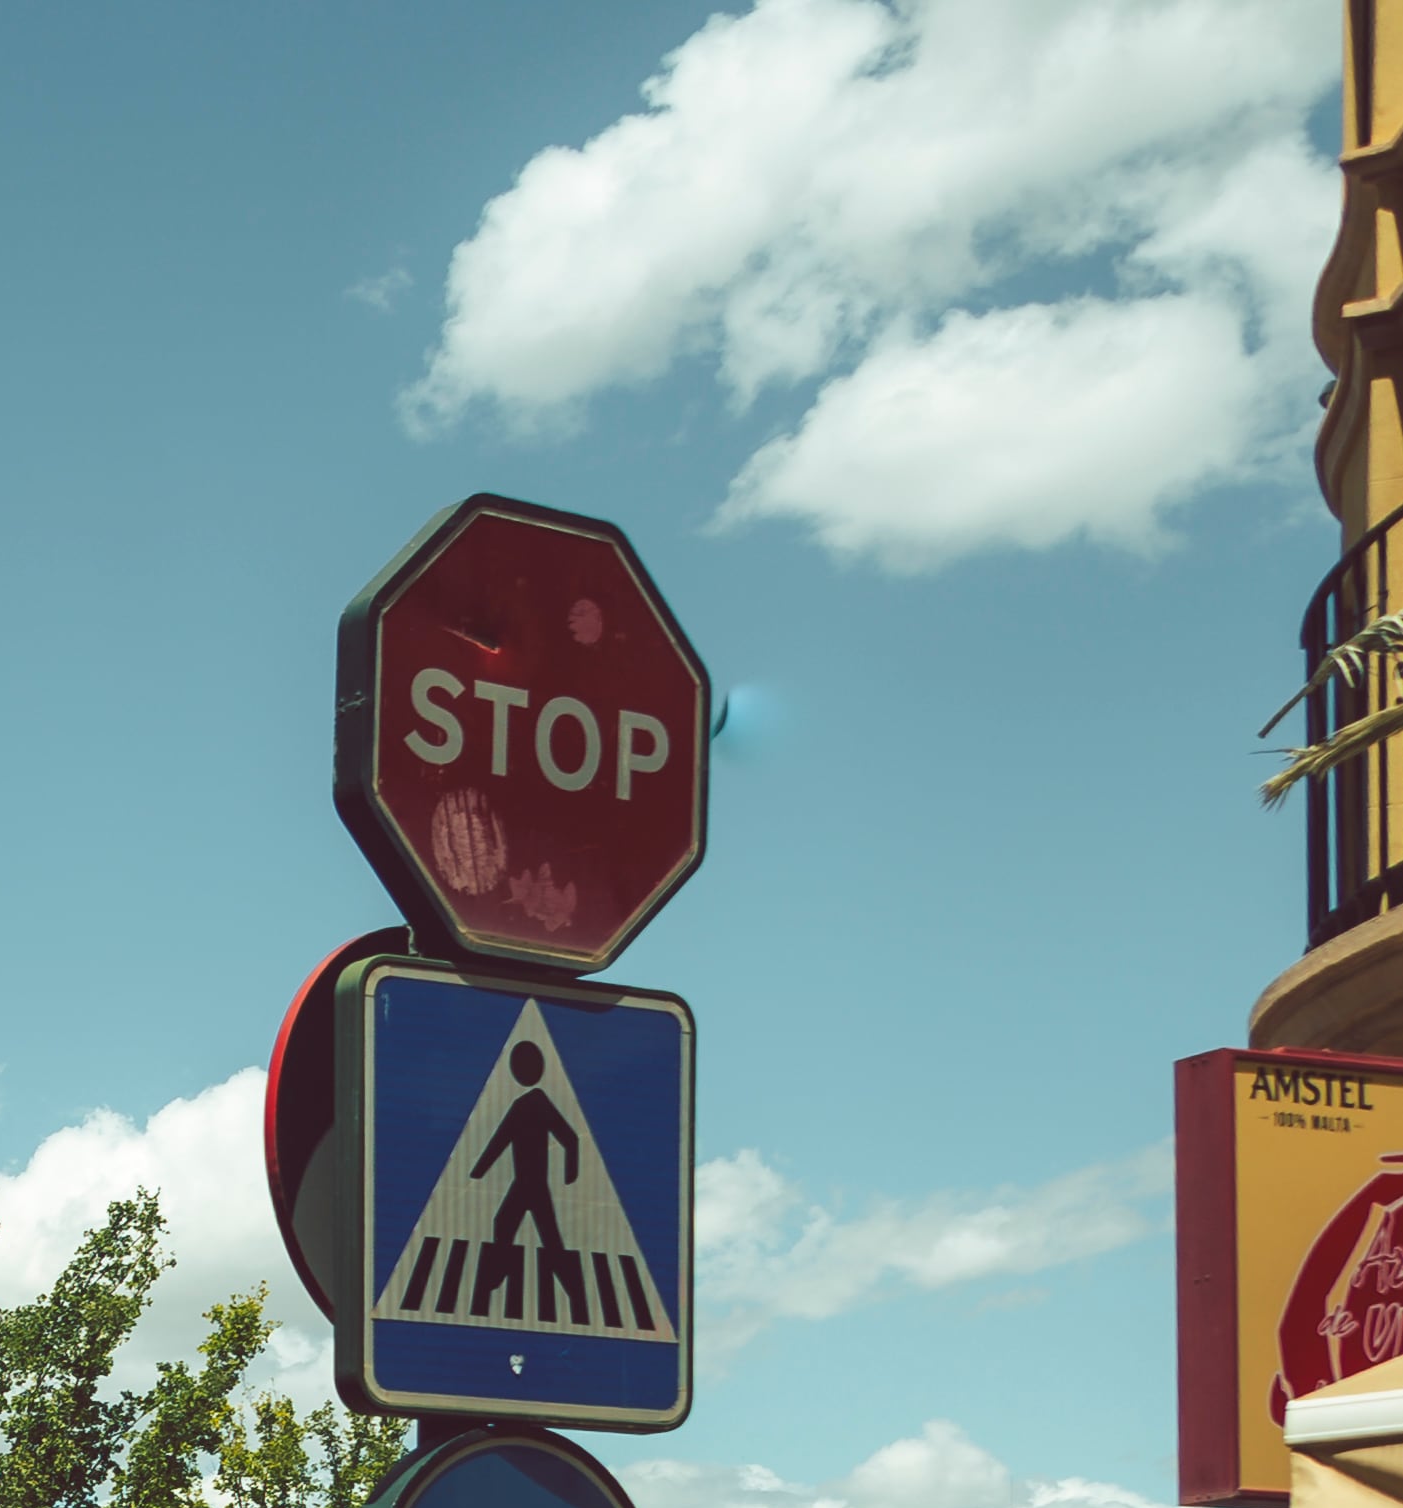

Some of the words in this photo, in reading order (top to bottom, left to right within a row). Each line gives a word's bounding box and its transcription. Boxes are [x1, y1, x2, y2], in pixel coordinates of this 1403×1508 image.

[403, 666, 670, 801] STOP
[1249, 1066, 1374, 1111] AMSTEL
[1273, 1111, 1307, 1130] 100%
[1310, 1114, 1351, 1133] MALTA
